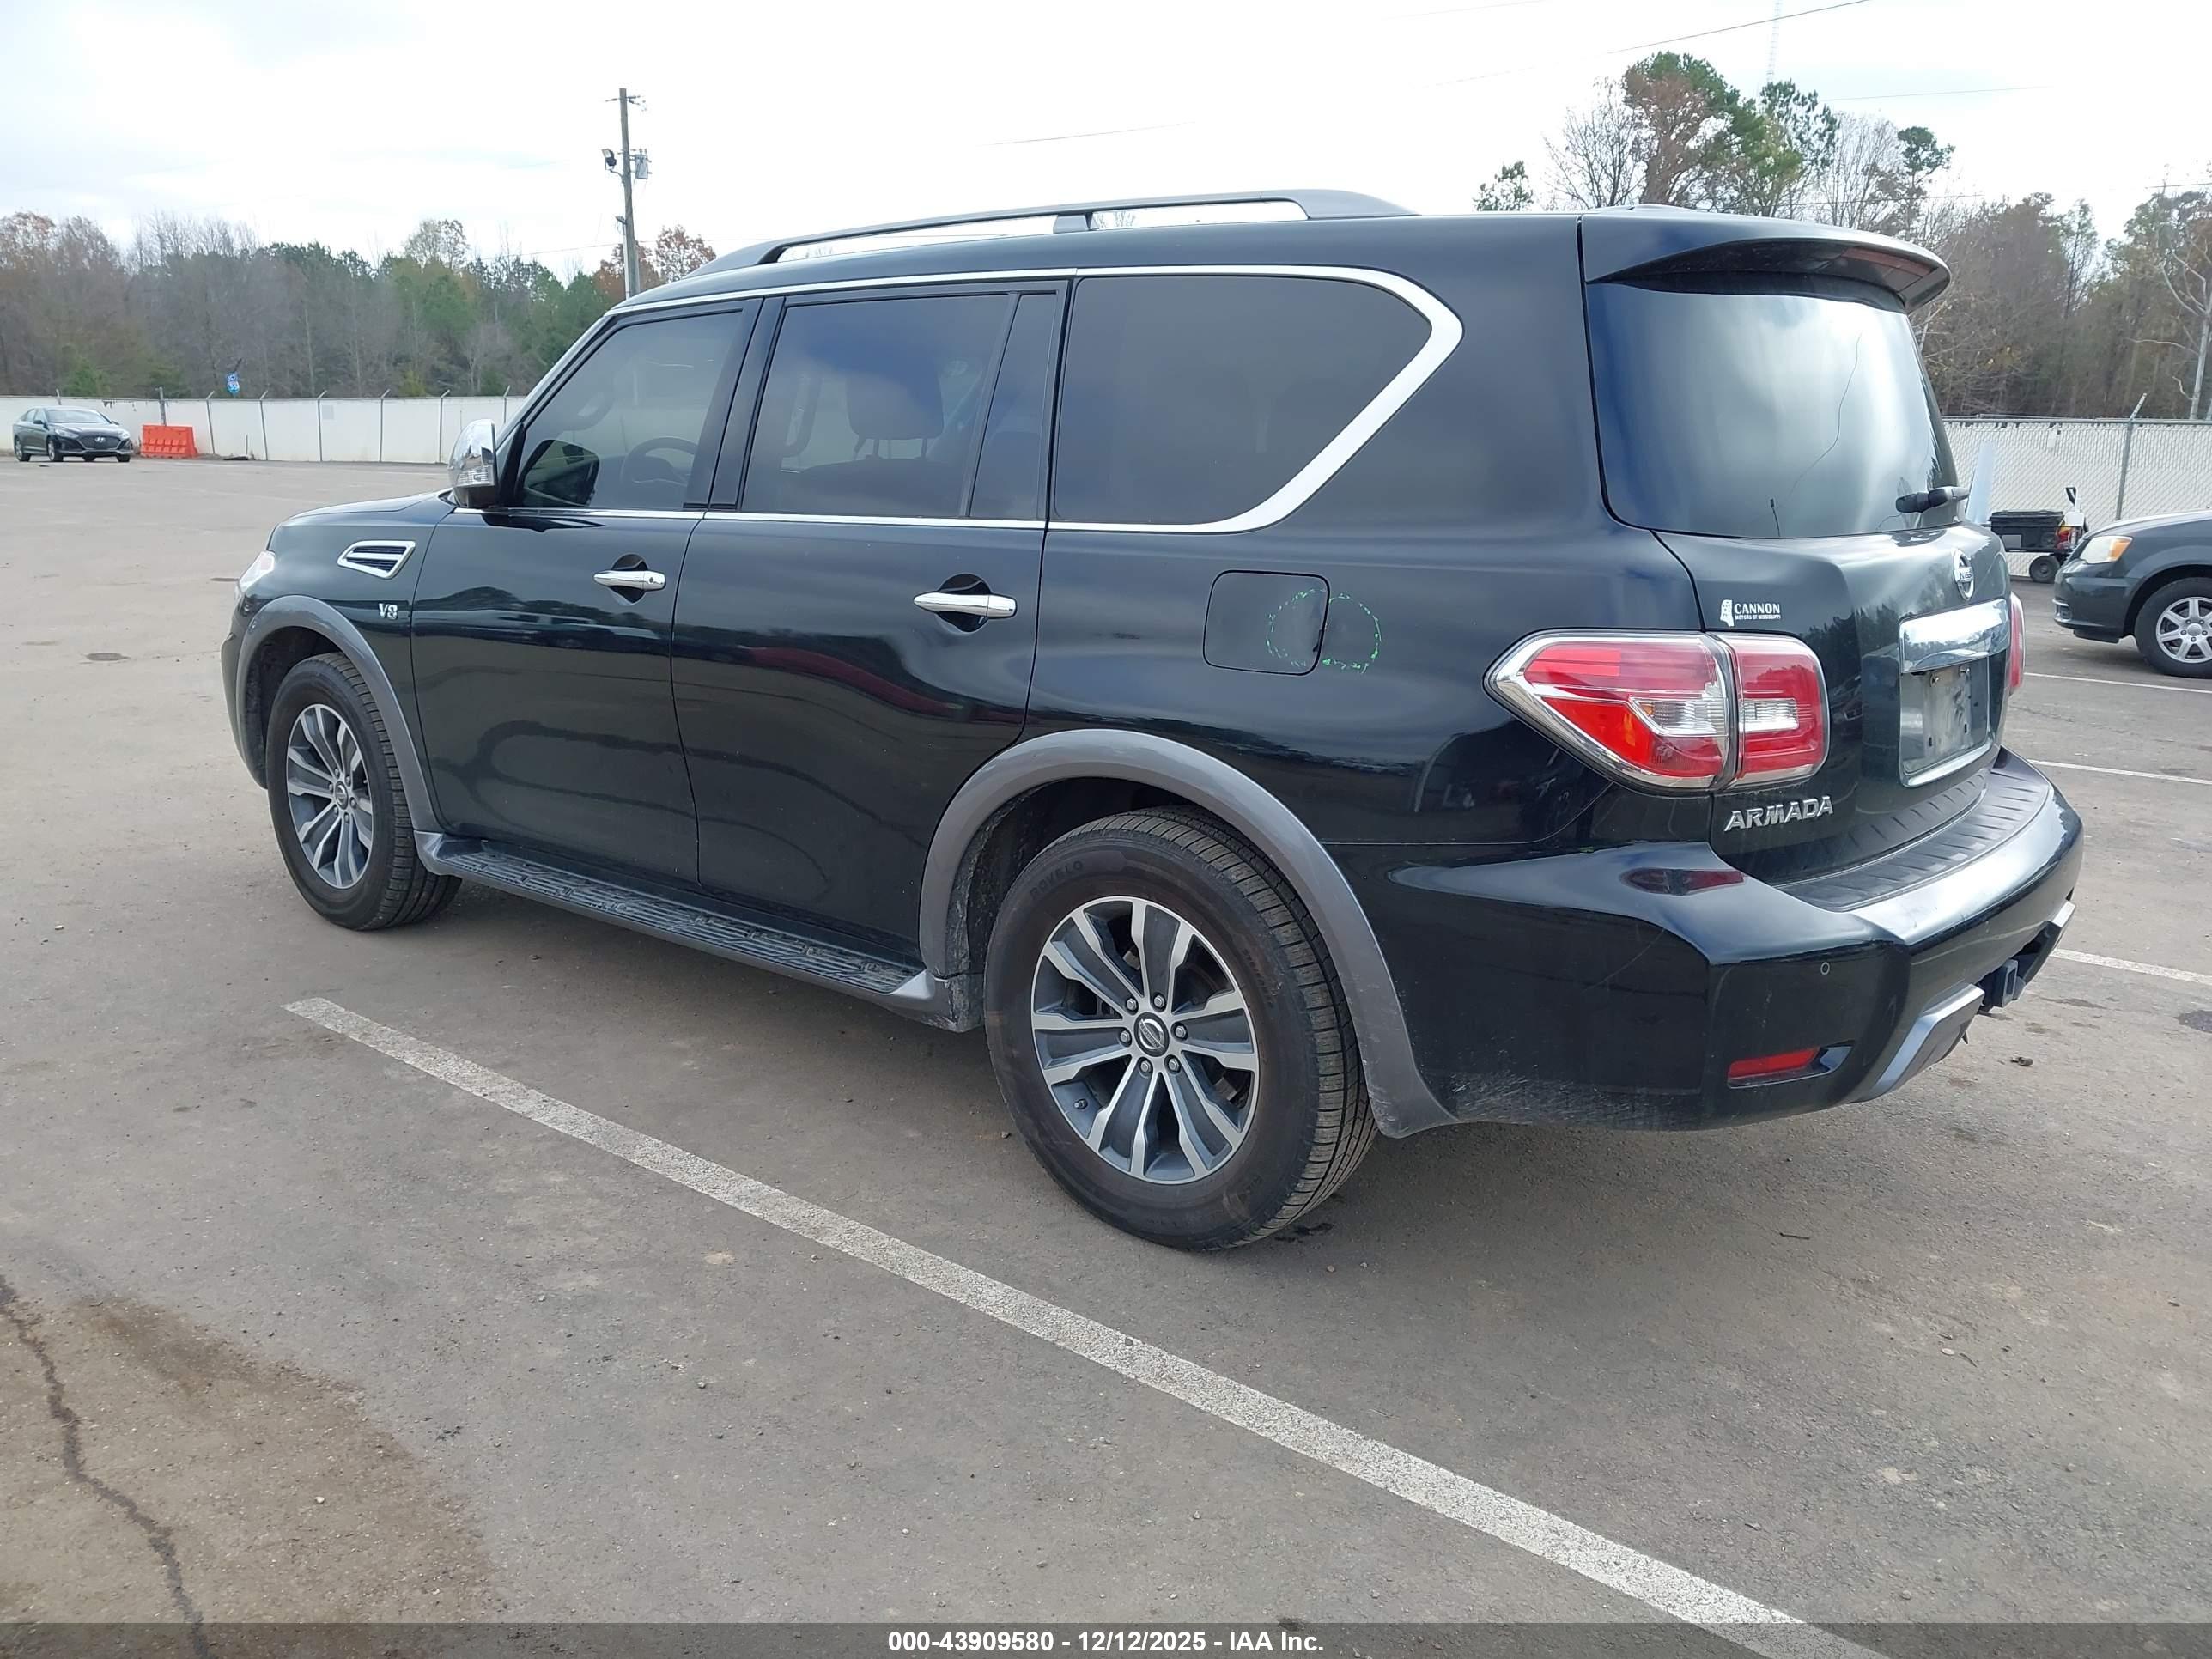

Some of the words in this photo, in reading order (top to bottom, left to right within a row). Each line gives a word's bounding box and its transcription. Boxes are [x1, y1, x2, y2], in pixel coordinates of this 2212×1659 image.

[378, 603, 398, 620] V8
[1734, 603, 1780, 614] CANNON
[1724, 795, 1833, 832] ARMADA
